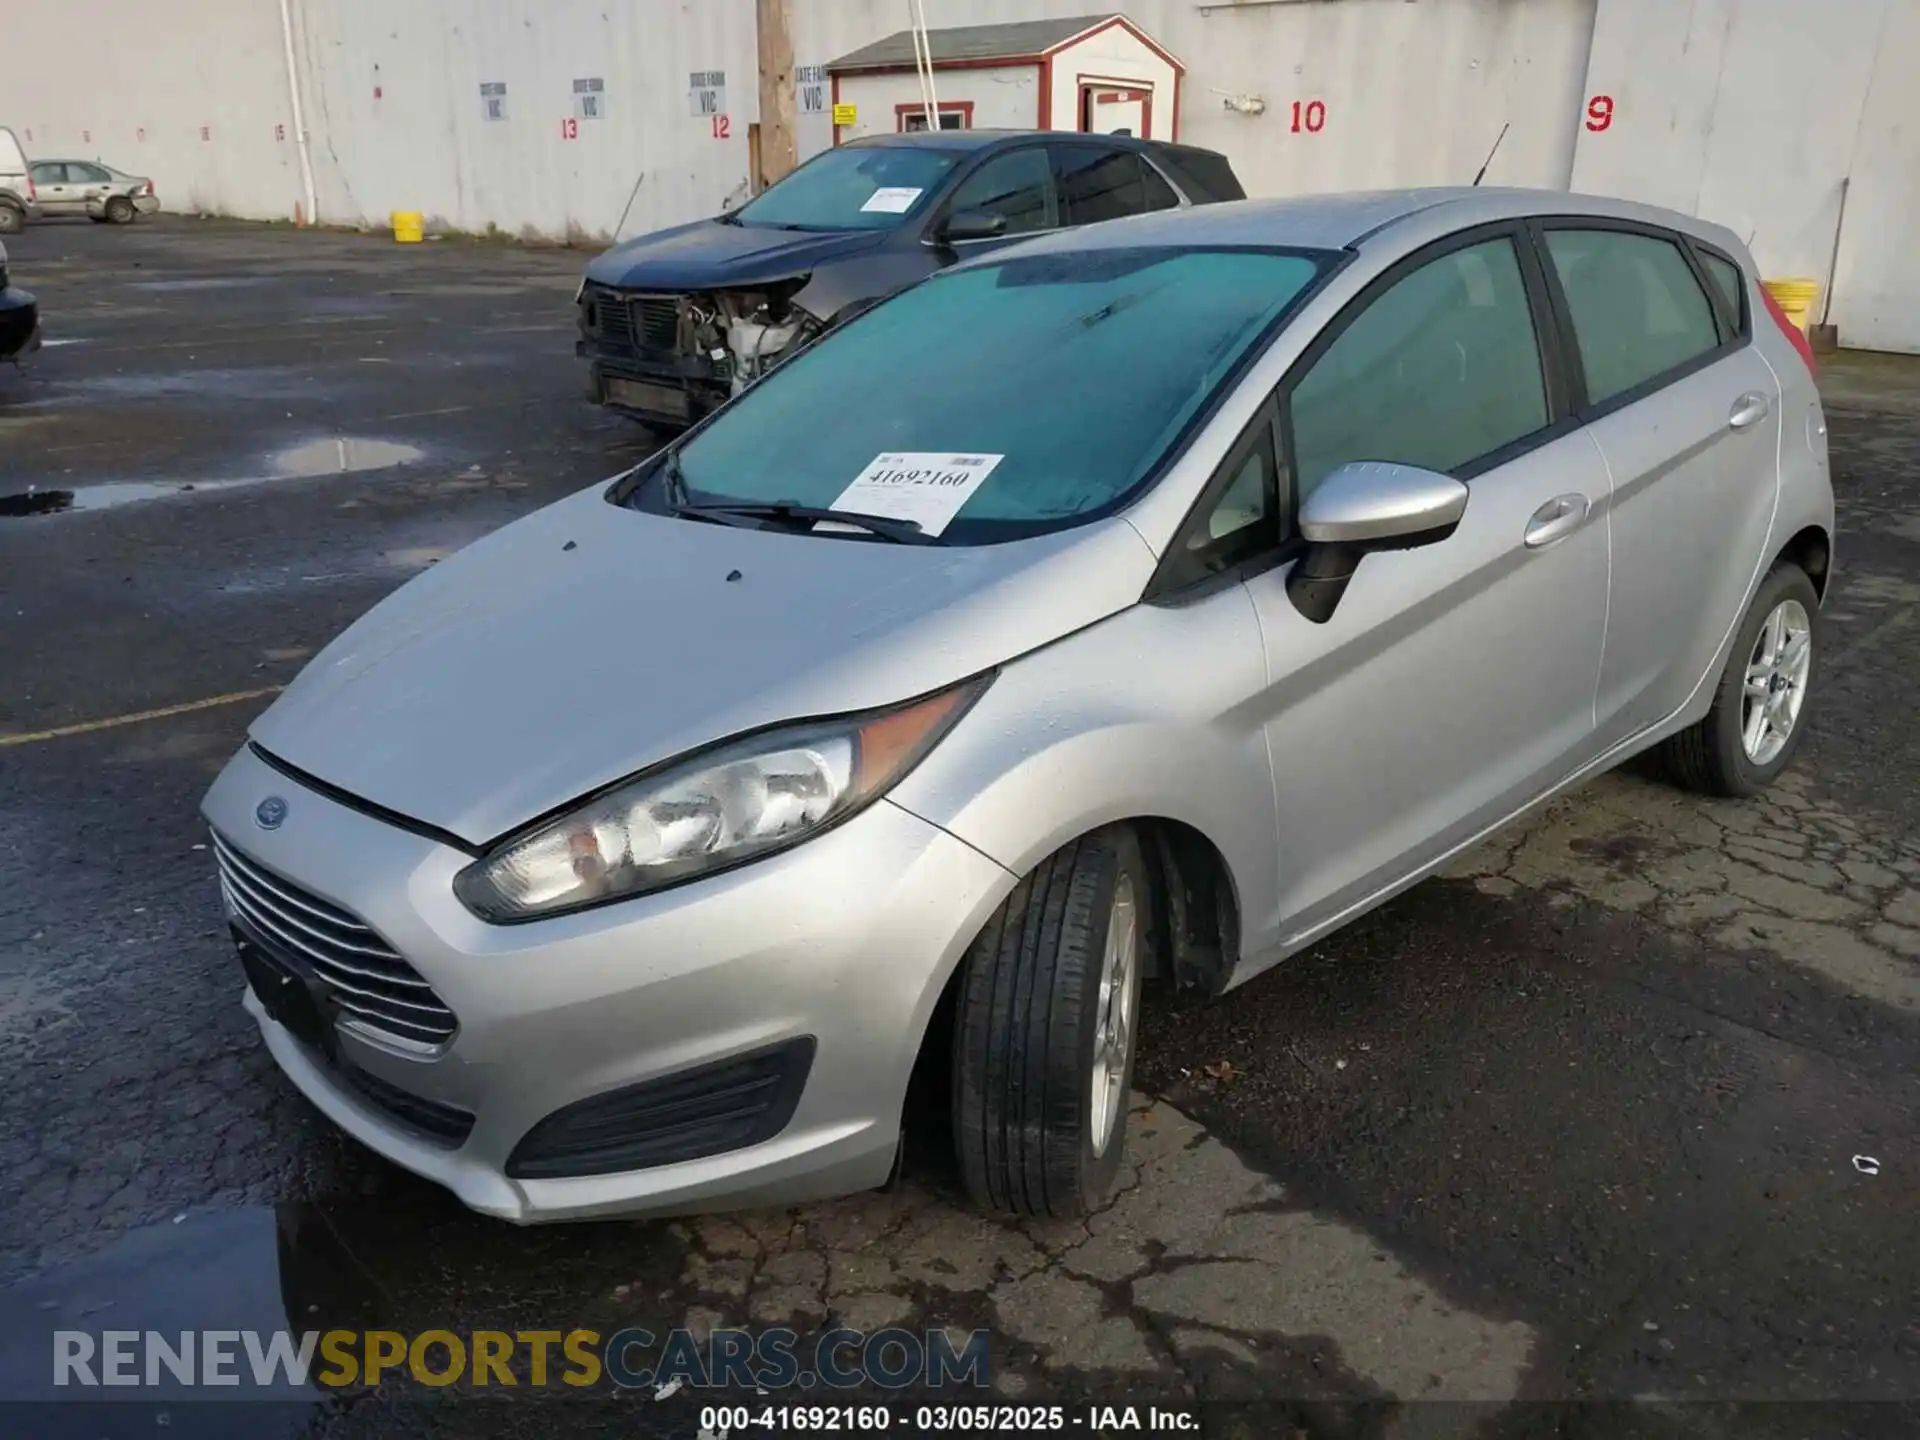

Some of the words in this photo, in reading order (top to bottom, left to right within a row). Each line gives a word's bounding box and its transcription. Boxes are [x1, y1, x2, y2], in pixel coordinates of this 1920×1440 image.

[699, 90, 717, 113] VIC
[803, 86, 822, 111] VIC
[1291, 100, 1325, 133] 10
[1586, 95, 1613, 132] 9
[562, 118, 578, 140] 13
[712, 115, 730, 139] 12
[869, 468, 971, 488] 41692160
